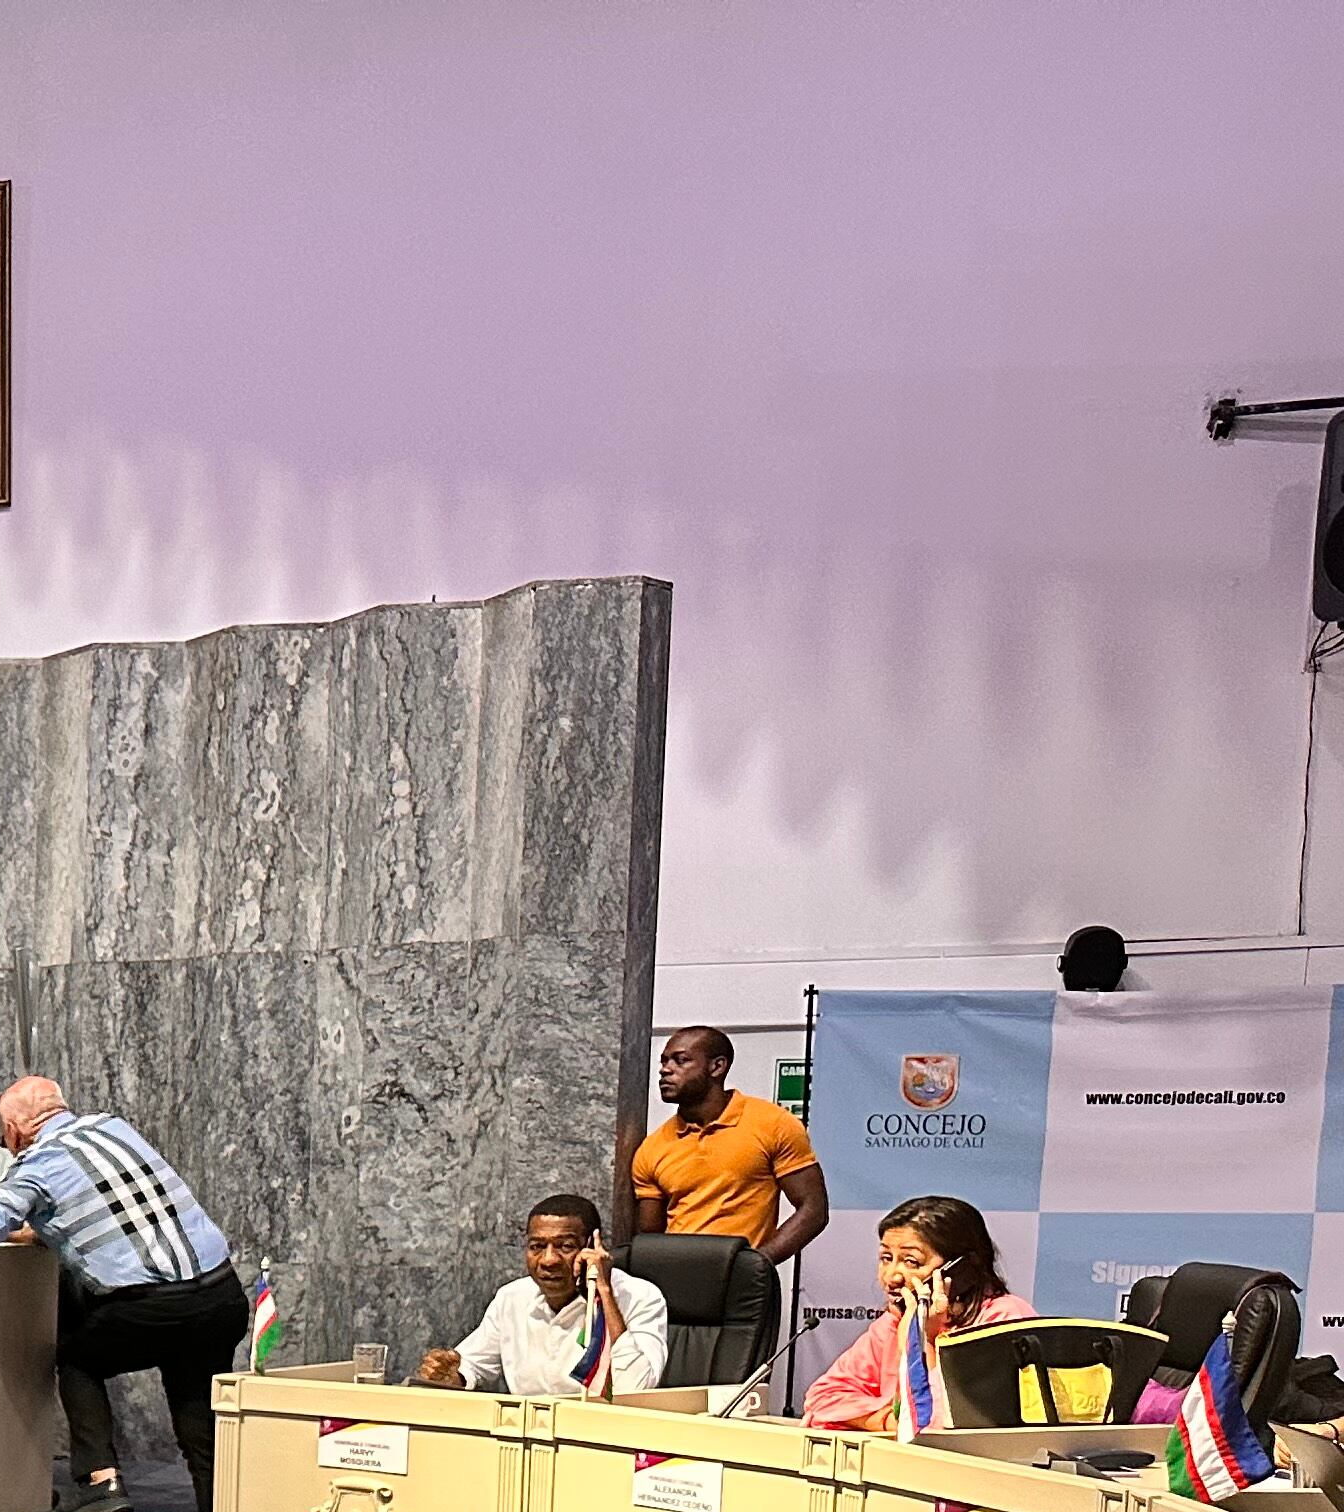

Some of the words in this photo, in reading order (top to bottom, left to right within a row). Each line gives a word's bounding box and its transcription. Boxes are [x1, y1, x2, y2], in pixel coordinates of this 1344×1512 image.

[1085, 1090, 1286, 1106] www.concejodecali.gov.co
[866, 1113, 987, 1136] CONCEJO
[864, 1137, 931, 1148] SANTIAGO
[934, 1137, 951, 1148] DE
[953, 1137, 985, 1148] CALI
[340, 1457, 382, 1467] MOSQUERA
[653, 1484, 697, 1498] ALEXANDRA
